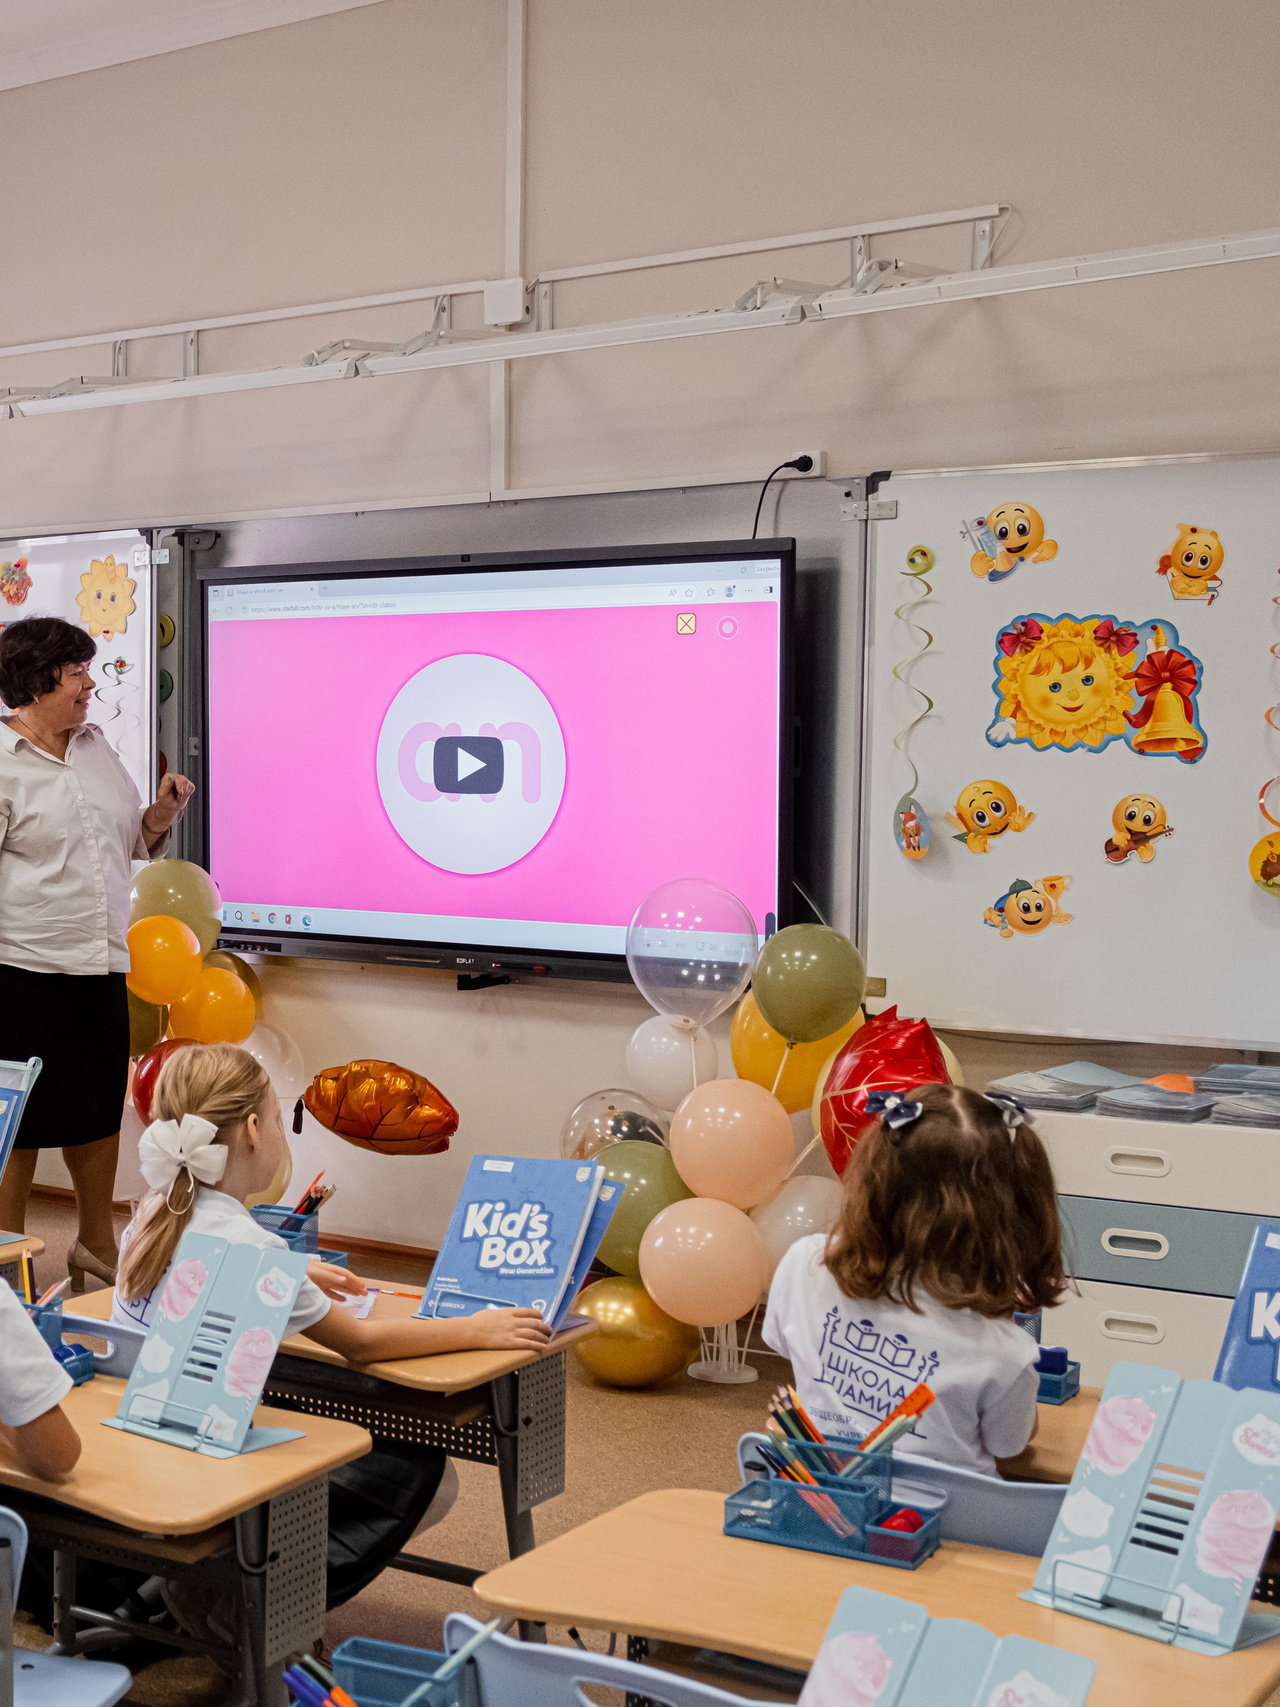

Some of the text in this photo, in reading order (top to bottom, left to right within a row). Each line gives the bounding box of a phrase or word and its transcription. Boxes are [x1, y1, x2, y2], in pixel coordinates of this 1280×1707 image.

[463, 1202, 549, 1239] Kid's
[516, 1267, 554, 1275] Generation
[827, 1352, 906, 1399] ШКОЛА
[827, 1371, 898, 1418] ШАМИ
